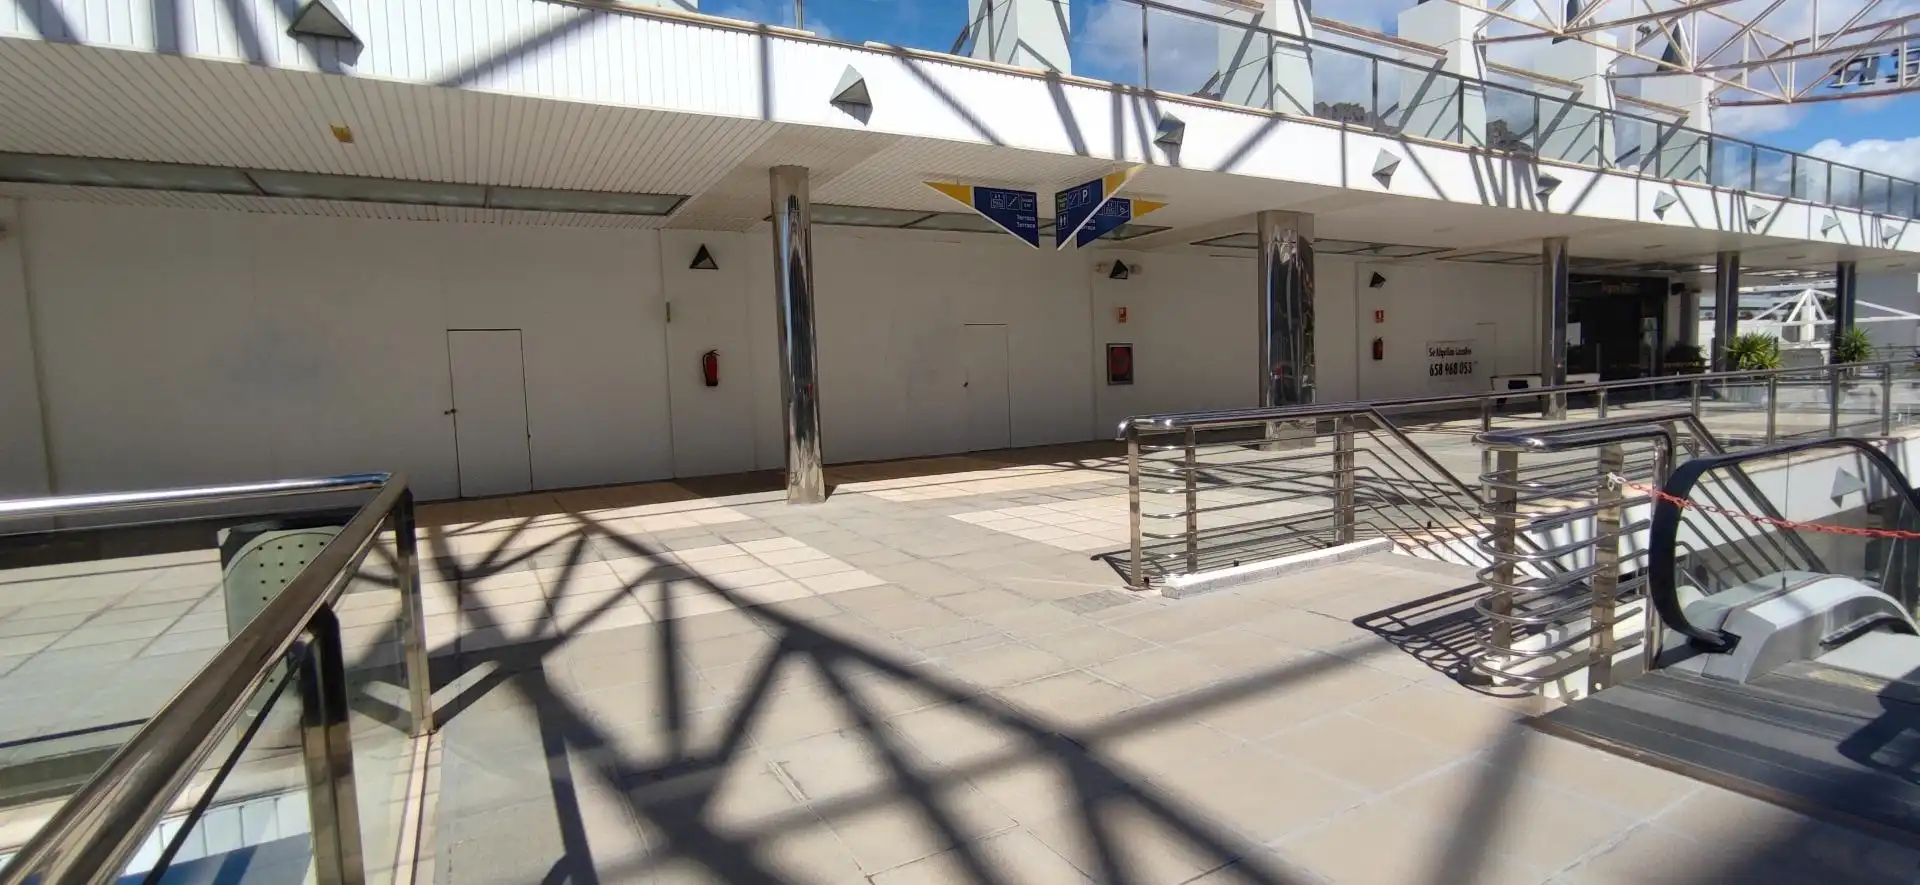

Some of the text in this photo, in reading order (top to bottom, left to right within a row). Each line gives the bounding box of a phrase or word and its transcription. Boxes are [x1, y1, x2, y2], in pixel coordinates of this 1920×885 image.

[1082, 189, 1088, 202] P
[1430, 363, 1443, 376] 658
[1459, 361, 1472, 374] 053
